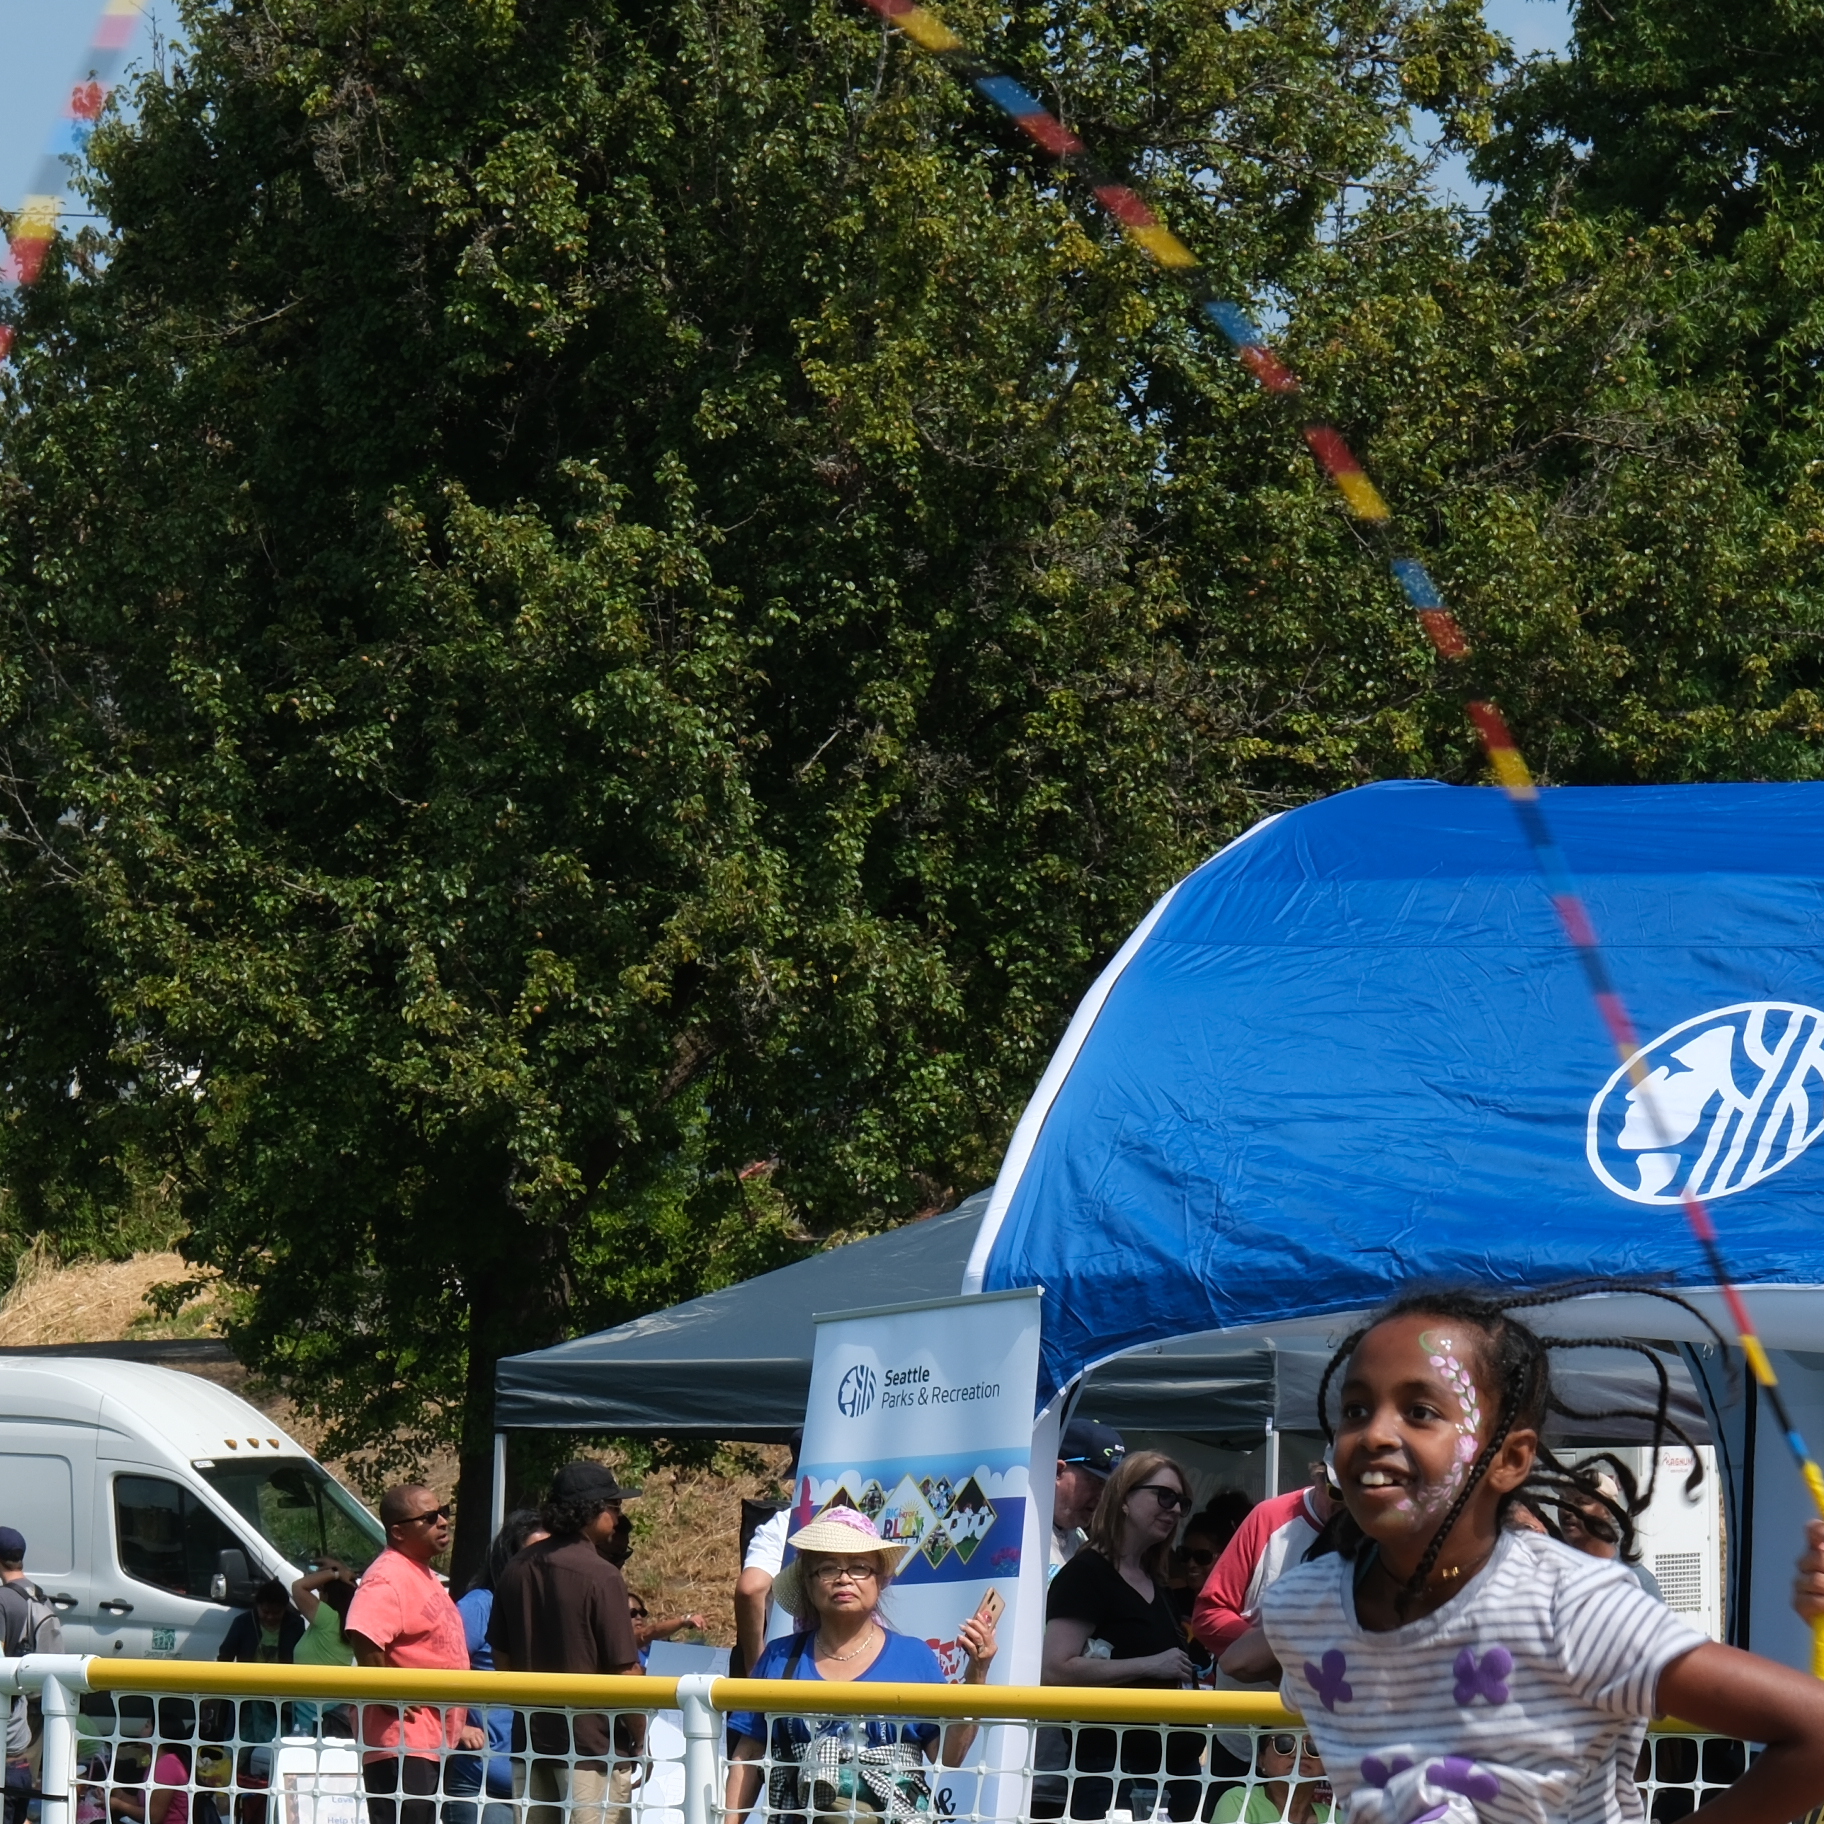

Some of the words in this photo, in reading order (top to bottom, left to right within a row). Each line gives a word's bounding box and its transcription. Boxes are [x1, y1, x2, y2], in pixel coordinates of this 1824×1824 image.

[884, 1365, 930, 1387] Seattle
[881, 1389, 914, 1409] Parks
[917, 1386, 929, 1406] &
[931, 1381, 1000, 1404] Recreation
[938, 1787, 957, 1823] &
[350, 1817, 366, 1824] te
